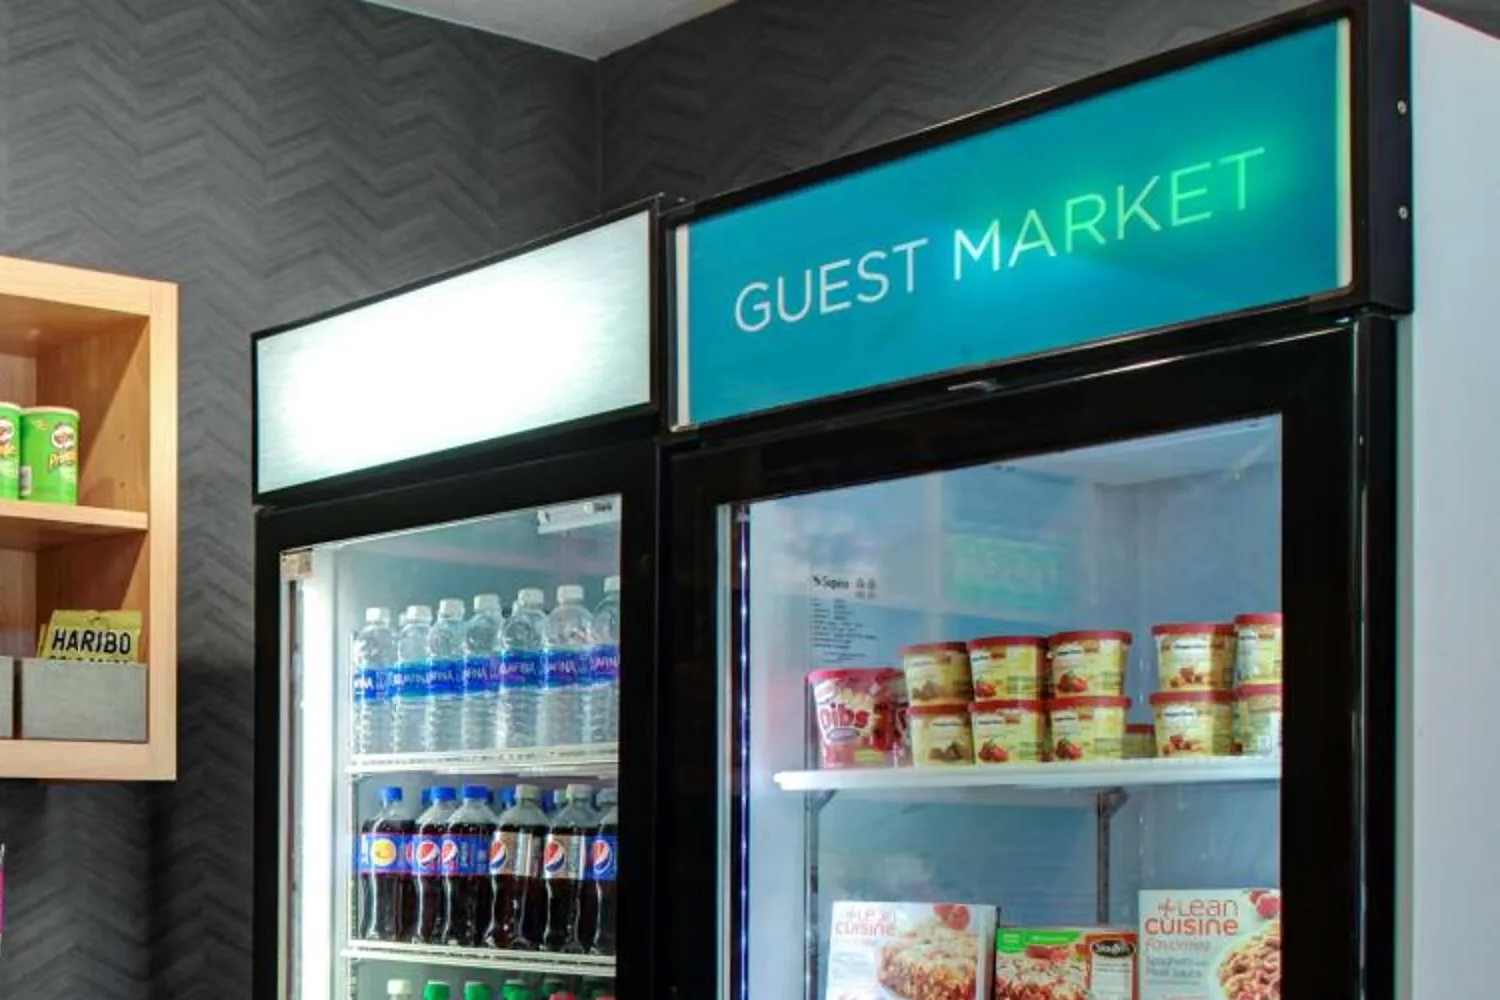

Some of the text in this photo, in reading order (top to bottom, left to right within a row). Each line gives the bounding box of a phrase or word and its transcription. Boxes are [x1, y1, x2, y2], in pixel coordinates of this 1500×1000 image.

[733, 146, 1266, 333] GUEST MARKET
[51, 628, 132, 655] HARIBO
[1177, 899, 1239, 917] Lean
[1144, 916, 1239, 936] cuisine
